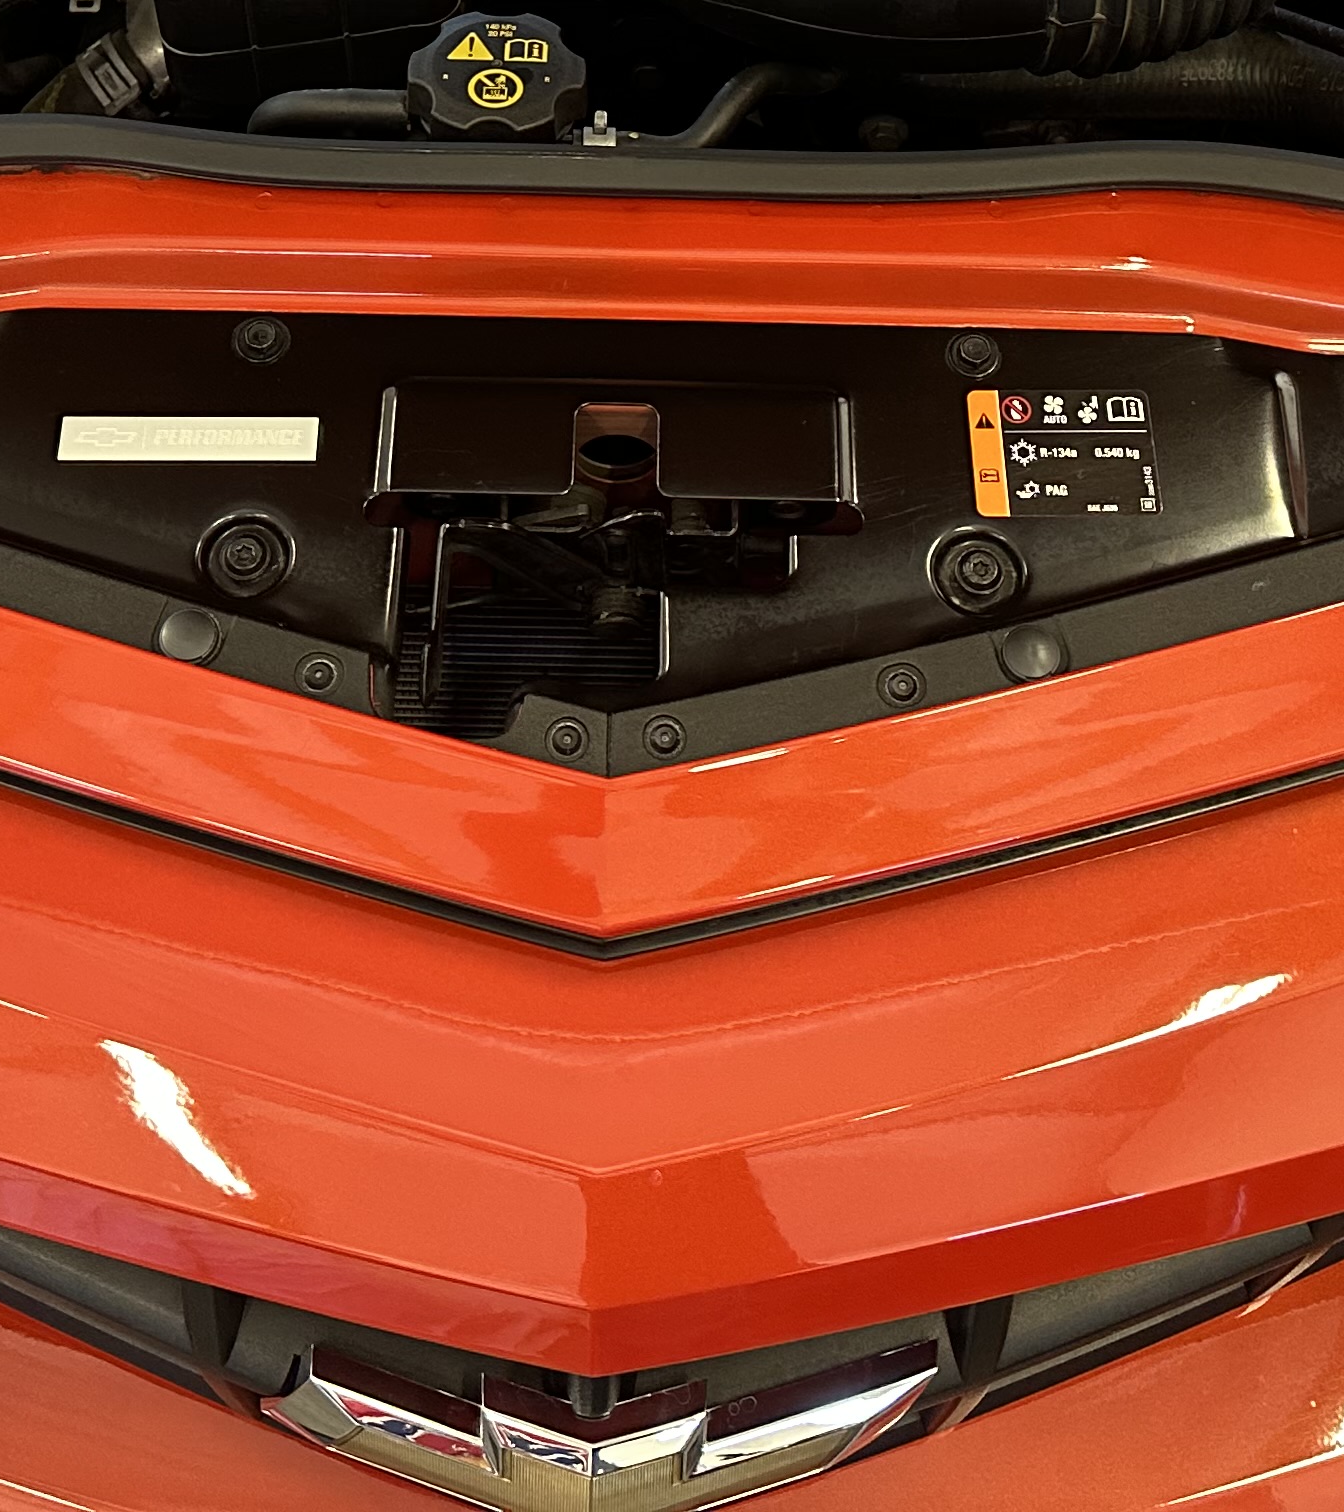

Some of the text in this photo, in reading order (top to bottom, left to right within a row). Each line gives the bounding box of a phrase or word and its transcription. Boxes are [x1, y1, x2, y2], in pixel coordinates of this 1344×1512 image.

[1043, 415, 1068, 424] AUTO
[152, 428, 306, 447] PERFORMANCE
[1039, 447, 1140, 460] R-134a 0.540 kg
[1045, 484, 1069, 496] PAG
